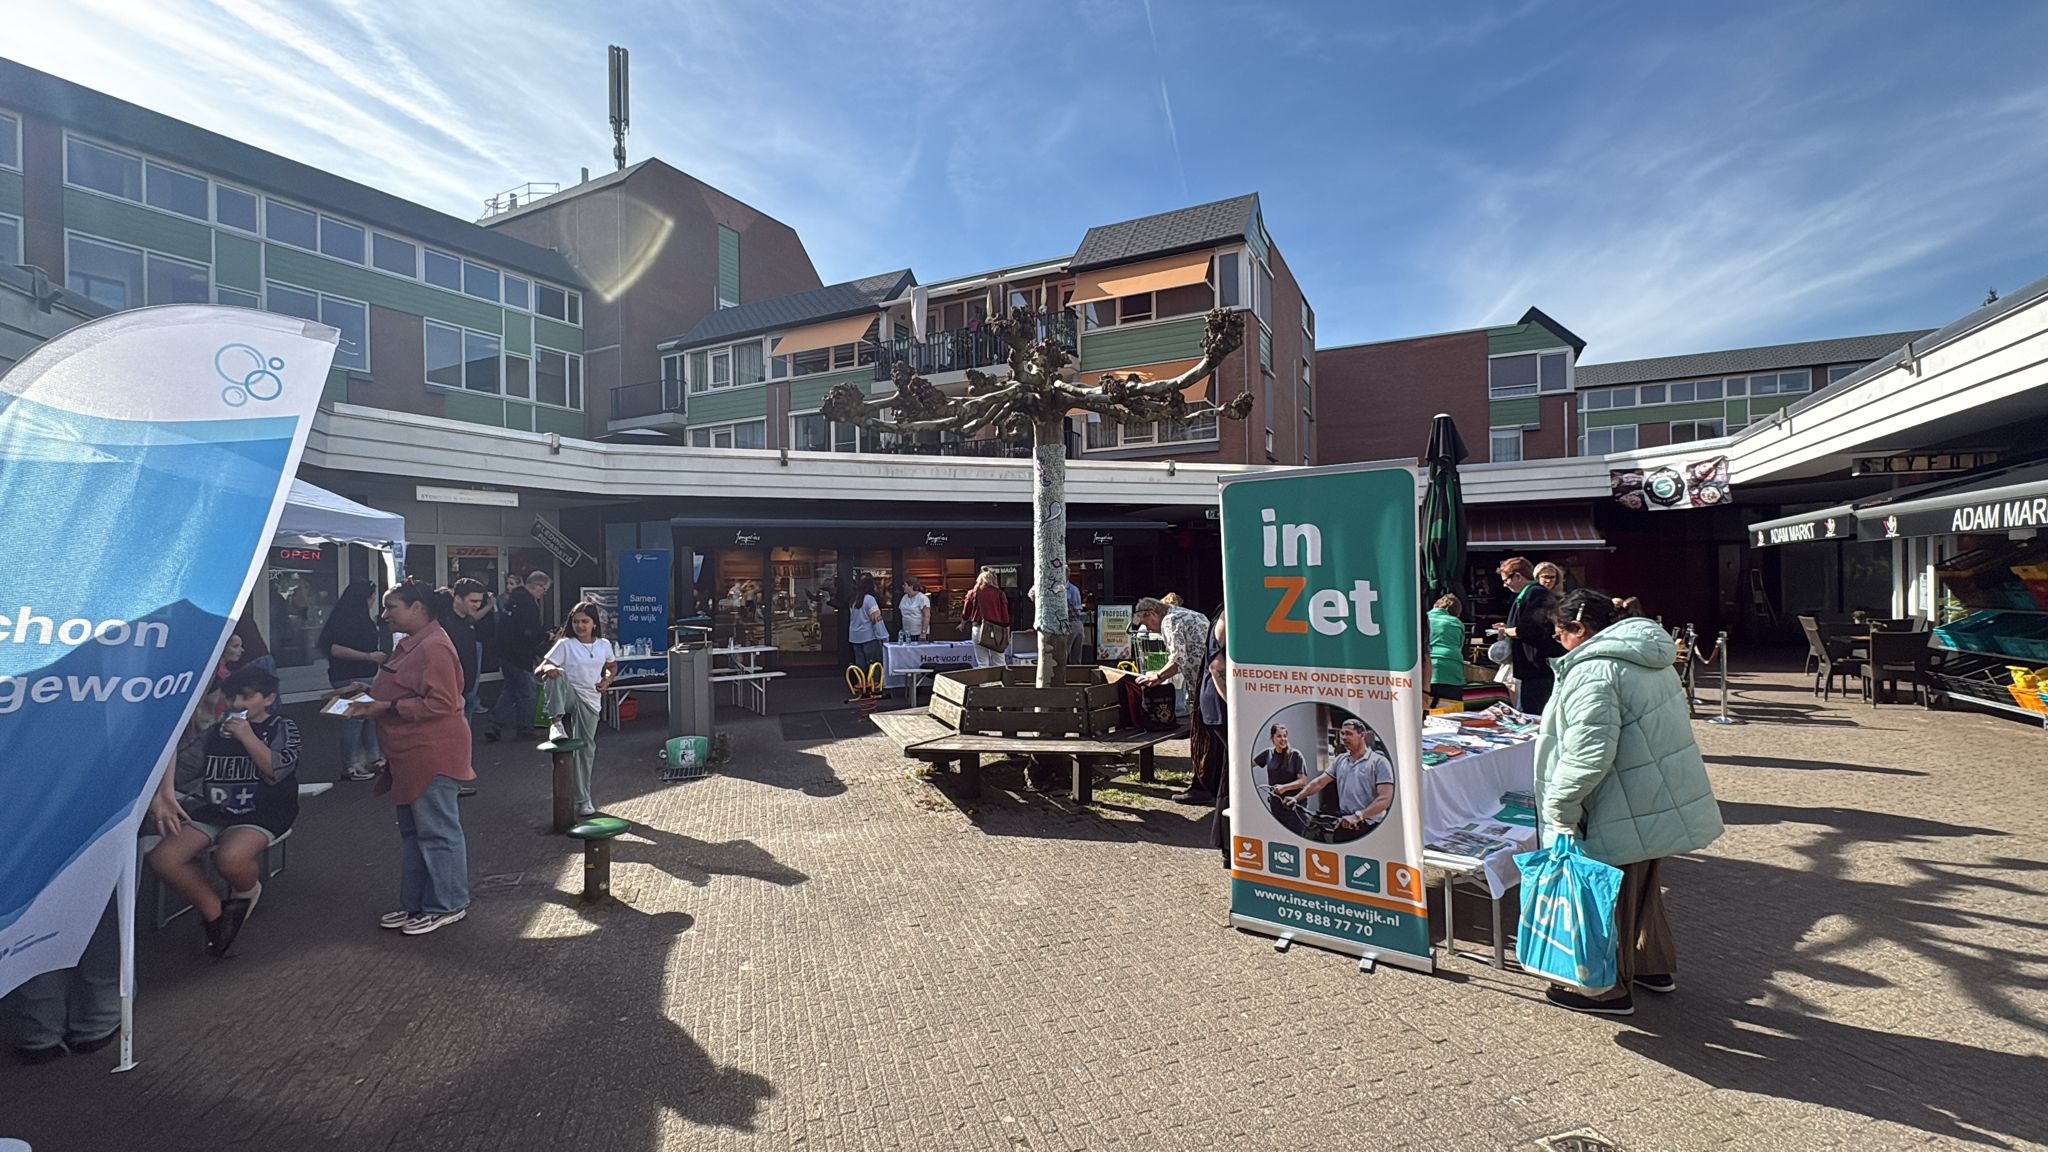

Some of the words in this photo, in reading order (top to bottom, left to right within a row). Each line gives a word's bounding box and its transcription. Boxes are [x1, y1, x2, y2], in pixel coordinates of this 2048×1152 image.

[1951, 504, 2000, 532] ADAM
[2003, 498, 2048, 527] MAR
[1261, 508, 1322, 567] in
[1770, 527, 1789, 544] ADAM
[1789, 522, 1816, 541] MARKT
[280, 549, 321, 560] OPEN
[623, 604, 650, 612] maken
[651, 604, 663, 614] wij
[629, 594, 657, 602] Samen
[1263, 576, 1380, 636] Zet
[628, 614, 639, 622] de
[640, 614, 657, 623] wijk
[1232, 668, 1288, 680] MEEDOEN
[1292, 672, 1307, 682] EN
[1311, 672, 1413, 689] ONDERSTEUNEN
[0, 671, 194, 714] gewoon
[1244, 682, 1257, 691] IN
[1260, 683, 1281, 693] HET
[1284, 684, 1315, 696] HART
[1317, 686, 1344, 698] VAN
[1347, 689, 1364, 699] DE
[1367, 689, 1399, 701] WIJK
[1254, 888, 1400, 927] www.inzet-indewijk.nl
[1277, 907, 1303, 920] 079
[1305, 913, 1331, 928] 888
[1334, 918, 1351, 932] 77
[1355, 923, 1373, 937] 70
